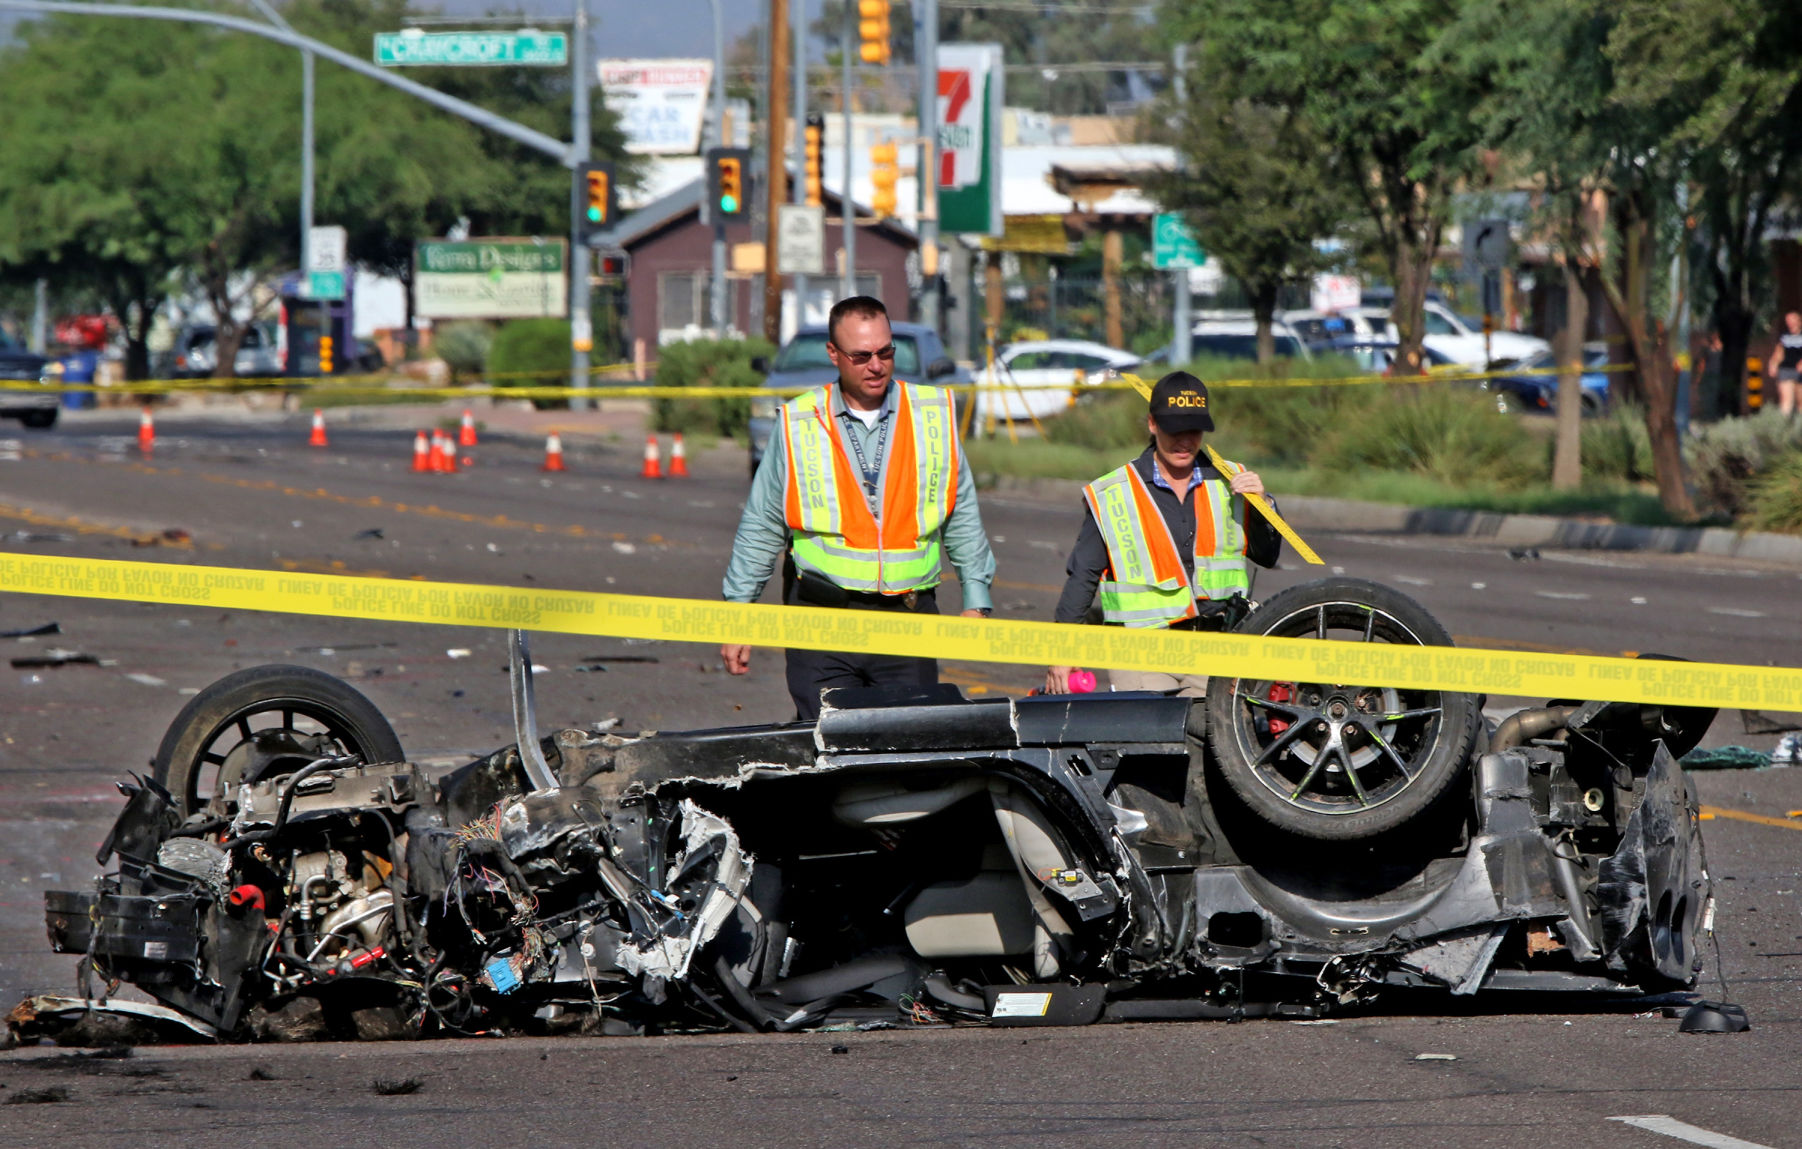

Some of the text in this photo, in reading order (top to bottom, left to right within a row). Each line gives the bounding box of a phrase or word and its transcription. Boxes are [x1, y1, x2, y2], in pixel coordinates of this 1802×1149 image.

[1168, 396, 1206, 408] POLICE
[804, 418, 824, 509] TUCSON
[926, 410, 939, 503] POLICE
[1108, 487, 1142, 580] TUCSON
